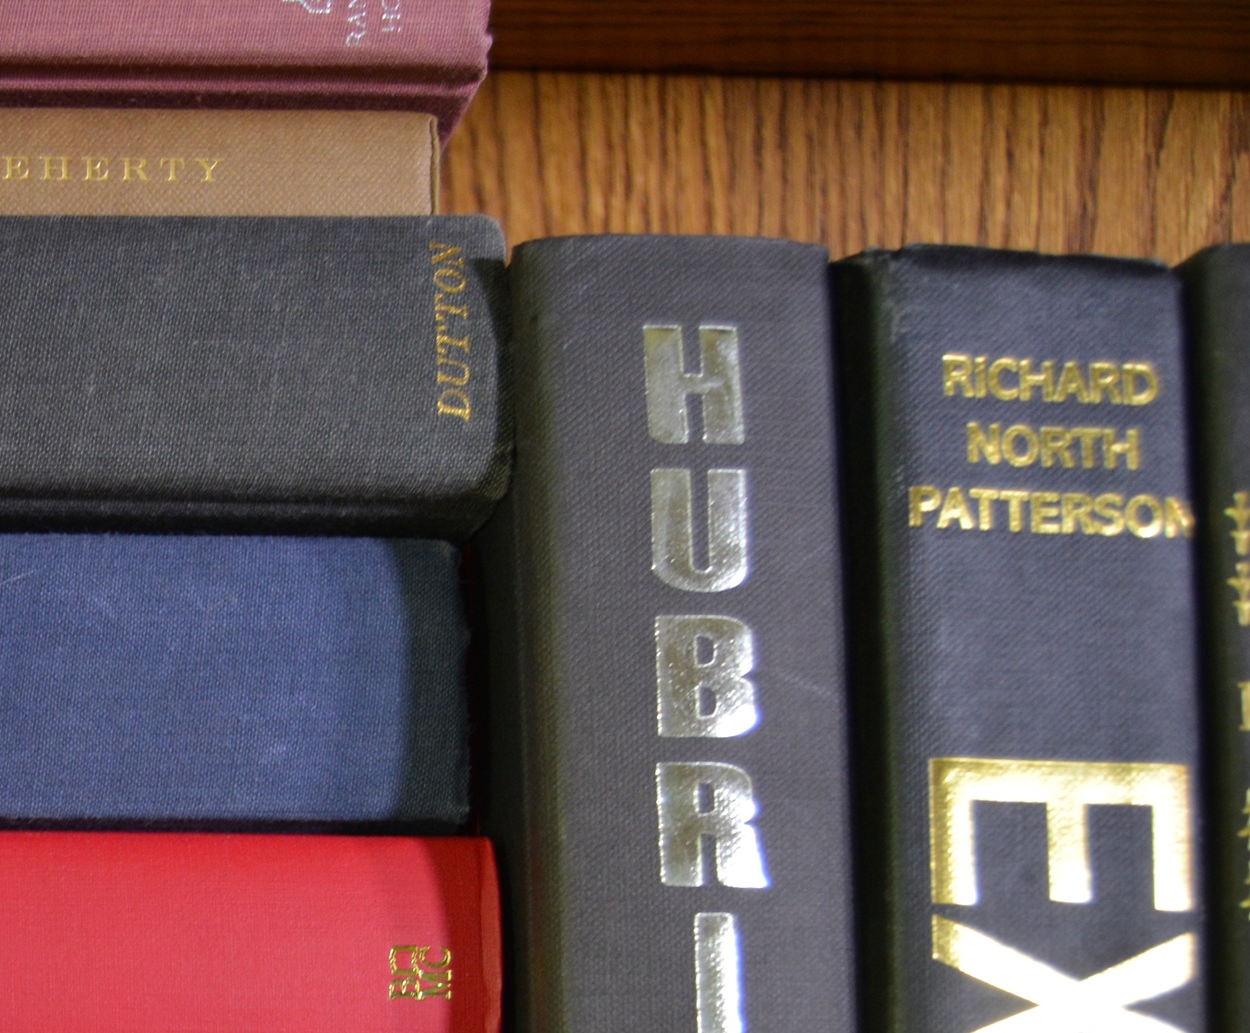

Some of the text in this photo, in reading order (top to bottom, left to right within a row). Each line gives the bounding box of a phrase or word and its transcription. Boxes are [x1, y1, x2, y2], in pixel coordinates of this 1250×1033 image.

[428, 241, 472, 423] DUTTON
[942, 353, 1160, 406] RICHARD
[966, 421, 1142, 471] NORTH
[907, 485, 1197, 539] PATTERSON
